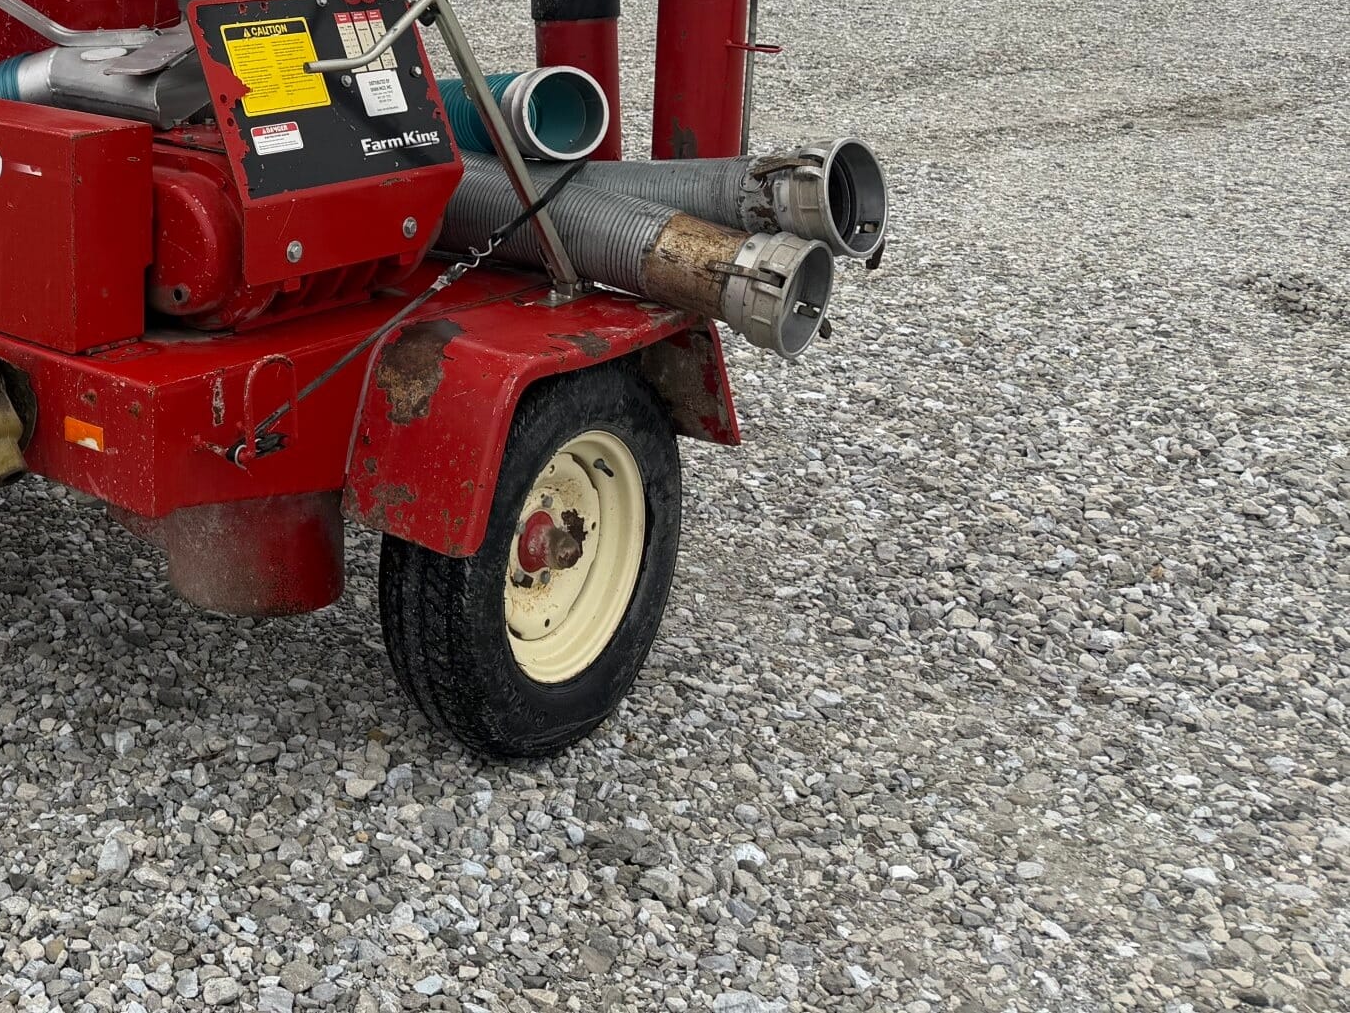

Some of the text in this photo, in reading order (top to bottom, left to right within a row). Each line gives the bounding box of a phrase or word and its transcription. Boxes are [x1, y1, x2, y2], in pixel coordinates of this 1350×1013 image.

[251, 23, 288, 37] CAUTION
[361, 130, 440, 153] Farm King
